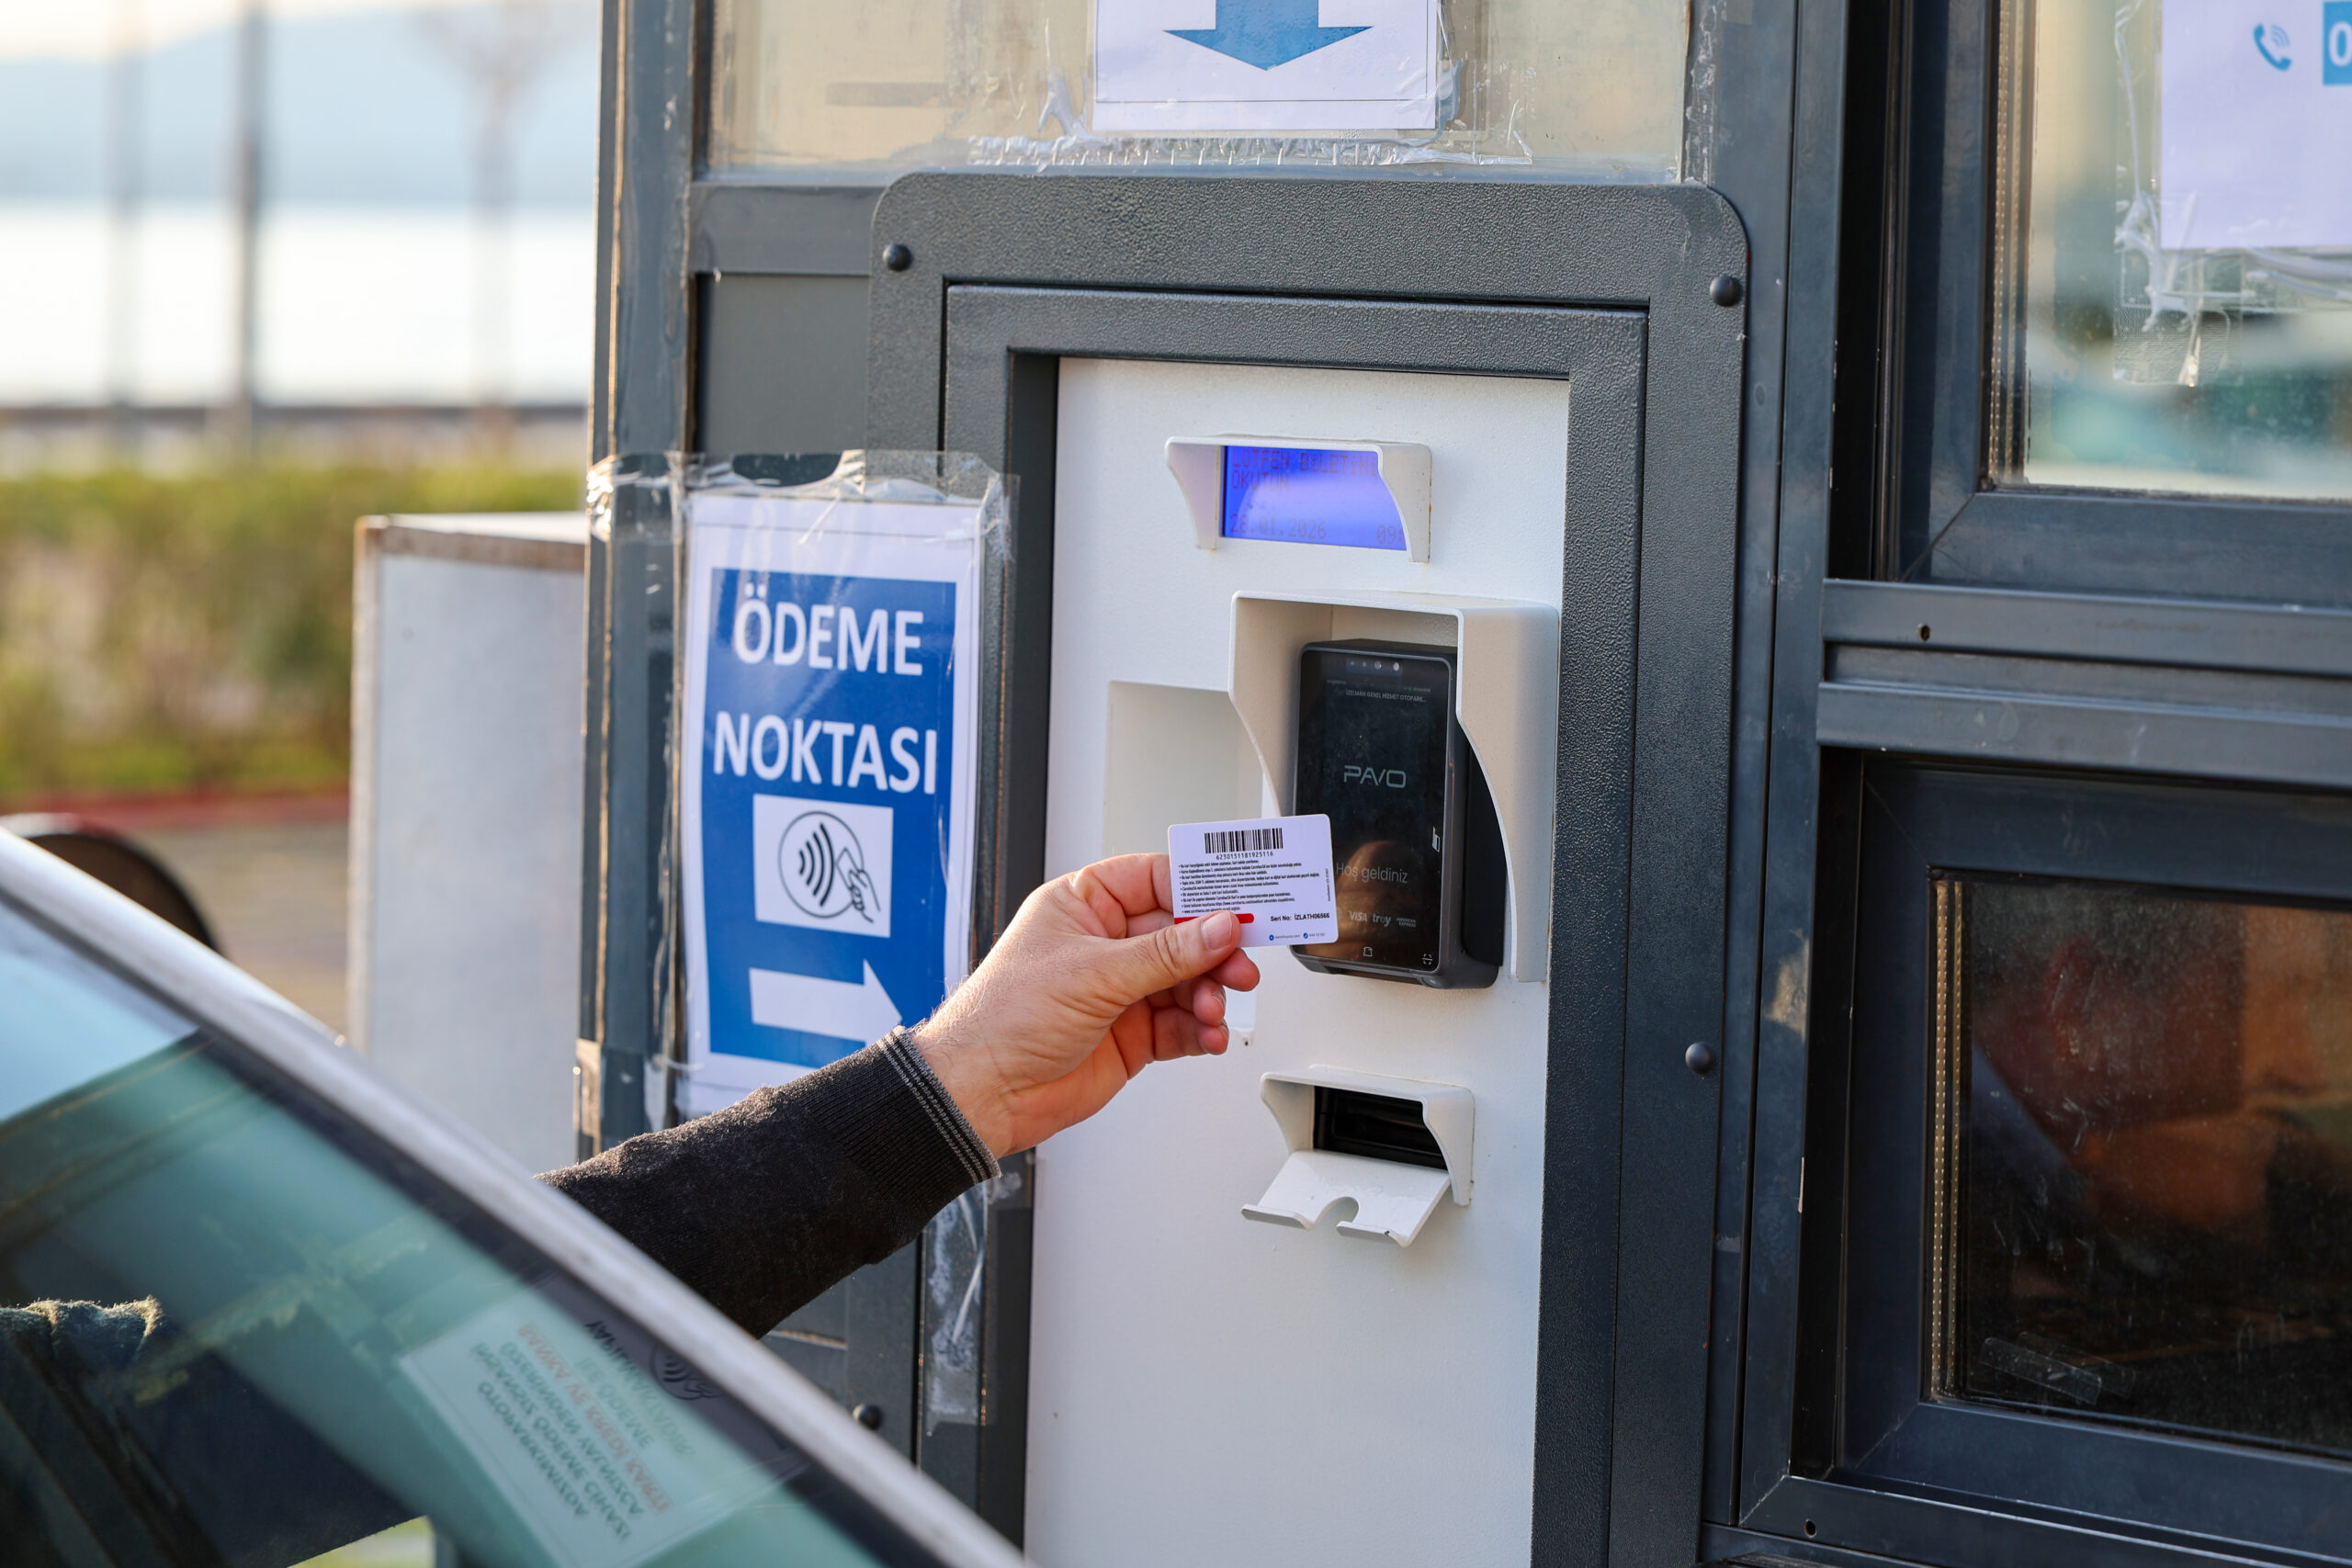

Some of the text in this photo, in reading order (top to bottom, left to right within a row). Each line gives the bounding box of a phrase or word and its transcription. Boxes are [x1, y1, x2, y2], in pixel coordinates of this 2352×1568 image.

[2328, 21, 2352, 67] 0
[1232, 469, 1290, 491] OKUTUN
[1230, 513, 1327, 539] 28.01.2026
[734, 582, 923, 676] ÖDEME
[714, 710, 937, 795] NOKTASI
[1343, 765, 1407, 788] PAVO
[1336, 863, 1358, 882] Hoş
[1362, 867, 1408, 884] geldiniz
[1350, 911, 1367, 922] VISA
[1373, 912, 1392, 927] troy
